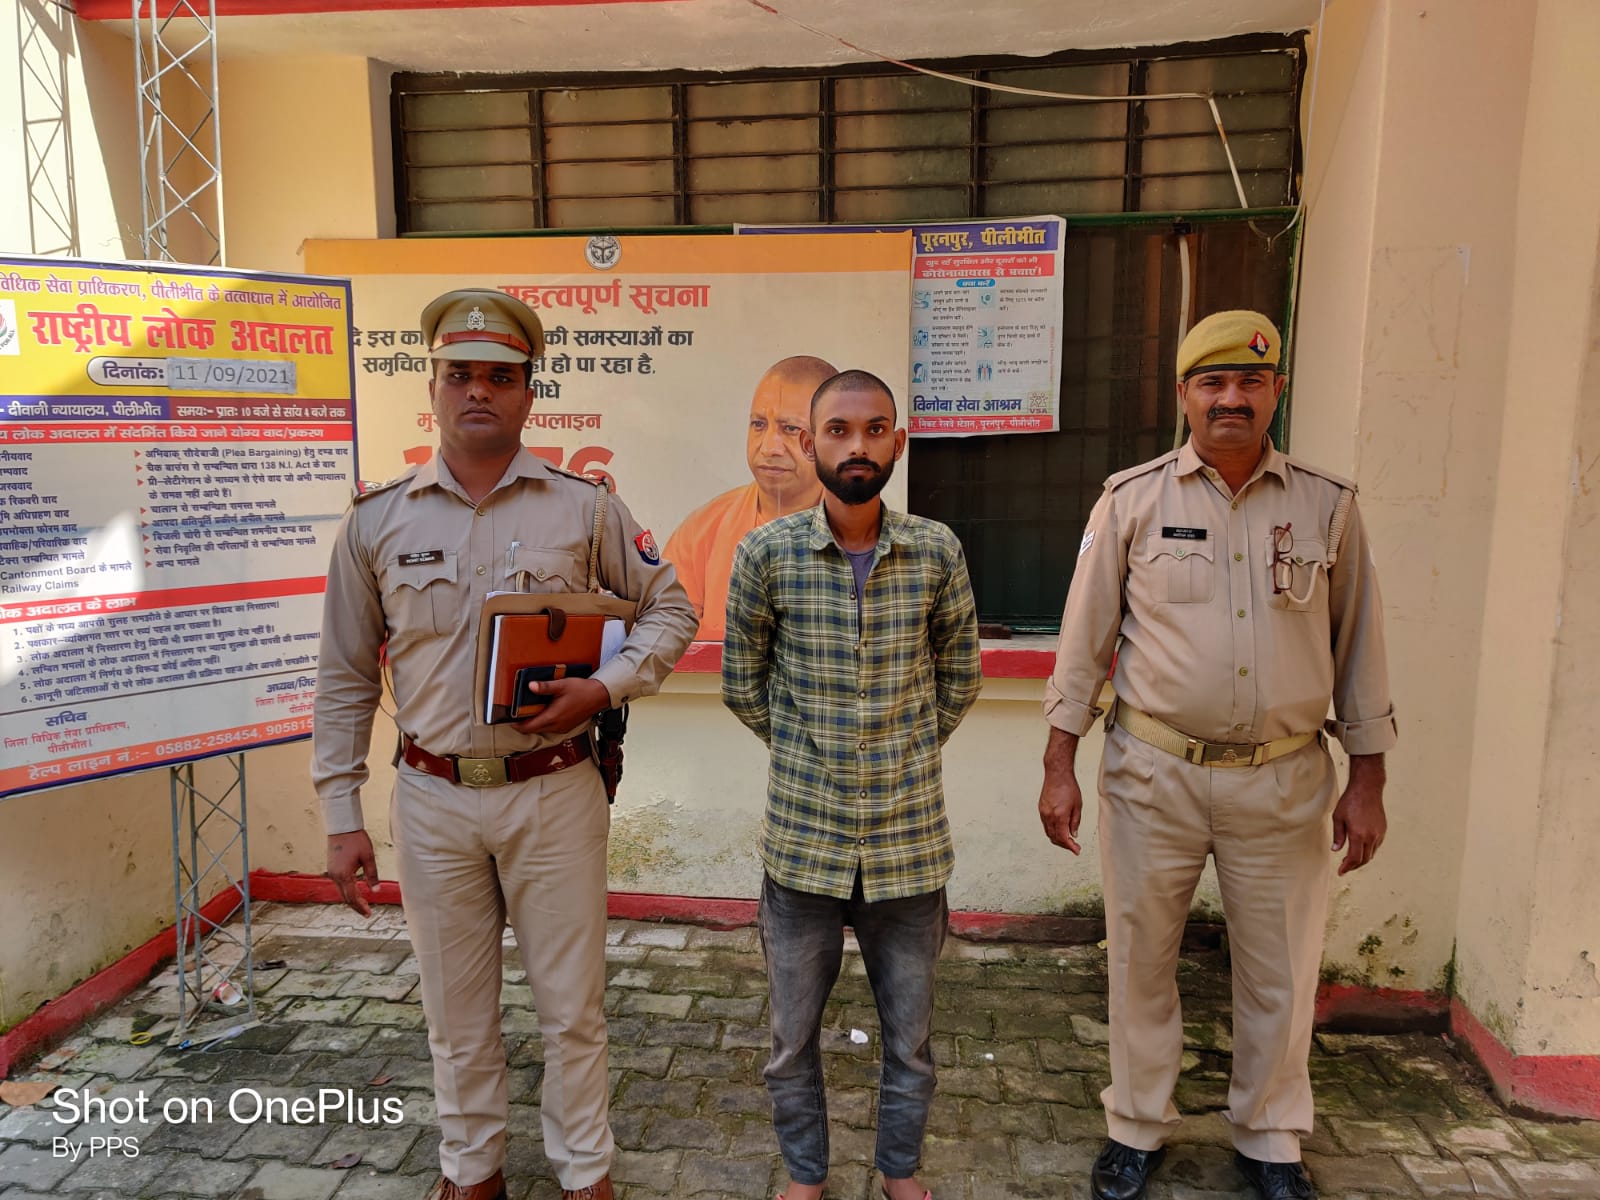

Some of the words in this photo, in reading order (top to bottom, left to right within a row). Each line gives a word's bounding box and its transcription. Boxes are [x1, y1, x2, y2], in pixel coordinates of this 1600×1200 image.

[921, 232, 973, 252] पूरनपुर,
[981, 226, 1046, 246] पीलीभीत
[46, 274, 72, 292] सेवा
[78, 277, 146, 300] प्राधिकरण,
[152, 280, 203, 302] पीलीभीत
[208, 284, 220, 302] के
[224, 290, 274, 306] तत्वाधान
[278, 290, 288, 306] में
[292, 292, 341, 310] आयोजित
[629, 285, 710, 314] सूचना
[28, 304, 132, 352] राष्ट्रीय
[142, 307, 216, 350] लोक
[230, 320, 334, 354] अदालत
[368, 329, 394, 347] इस
[574, 326, 662, 347] समस्याओं
[668, 331, 694, 346] का
[363, 352, 426, 376] समुचित
[552, 354, 572, 374] हो
[576, 358, 595, 373] पा
[600, 358, 631, 374] रहा
[8, 400, 48, 416] दीवानी
[52, 404, 109, 416] न्यायालय,
[112, 400, 161, 416] पीलीभीत
[272, 404, 282, 417] से
[330, 406, 346, 418] तक
[913, 396, 953, 412] विनोबा
[956, 396, 980, 412] सेवा
[983, 399, 1022, 410] आश्रम
[522, 412, 602, 432] ल्पलाइन
[12, 426, 44, 440] लोक
[50, 428, 100, 438] अदालत
[104, 426, 118, 438] में
[120, 426, 167, 438] संदर्भित
[170, 425, 196, 438] किये
[200, 426, 227, 438] जाने
[231, 426, 260, 438] योग्य
[222, 448, 246, 458] (Plea
[248, 448, 301, 458] Bargaining)
[260, 462, 276, 470] 138
[8, 494, 39, 506] रिकवरी
[41, 496, 58, 504] वाद
[54, 510, 70, 518] वाद
[36, 522, 60, 534] फोरम
[62, 524, 78, 532] वाद
[72, 537, 88, 546] वाद
[0, 567, 63, 580] Cantonment
[66, 564, 96, 576] Board
[99, 562, 107, 572] के
[110, 560, 132, 572] मामले
[2, 583, 42, 594] Railway
[45, 580, 79, 590] Claims
[26, 600, 82, 617] अदालत
[86, 598, 102, 610] के
[106, 597, 136, 609] लाभ
[30, 652, 50, 662] लोक
[53, 648, 84, 658] अदालत
[100, 654, 118, 665] लोक
[33, 678, 52, 689] लोक
[56, 674, 87, 684] अदालत
[44, 710, 88, 727] सचिव
[28, 764, 61, 780] हेल्प
[68, 755, 110, 772] लाइन
[266, 718, 314, 735] 905815
